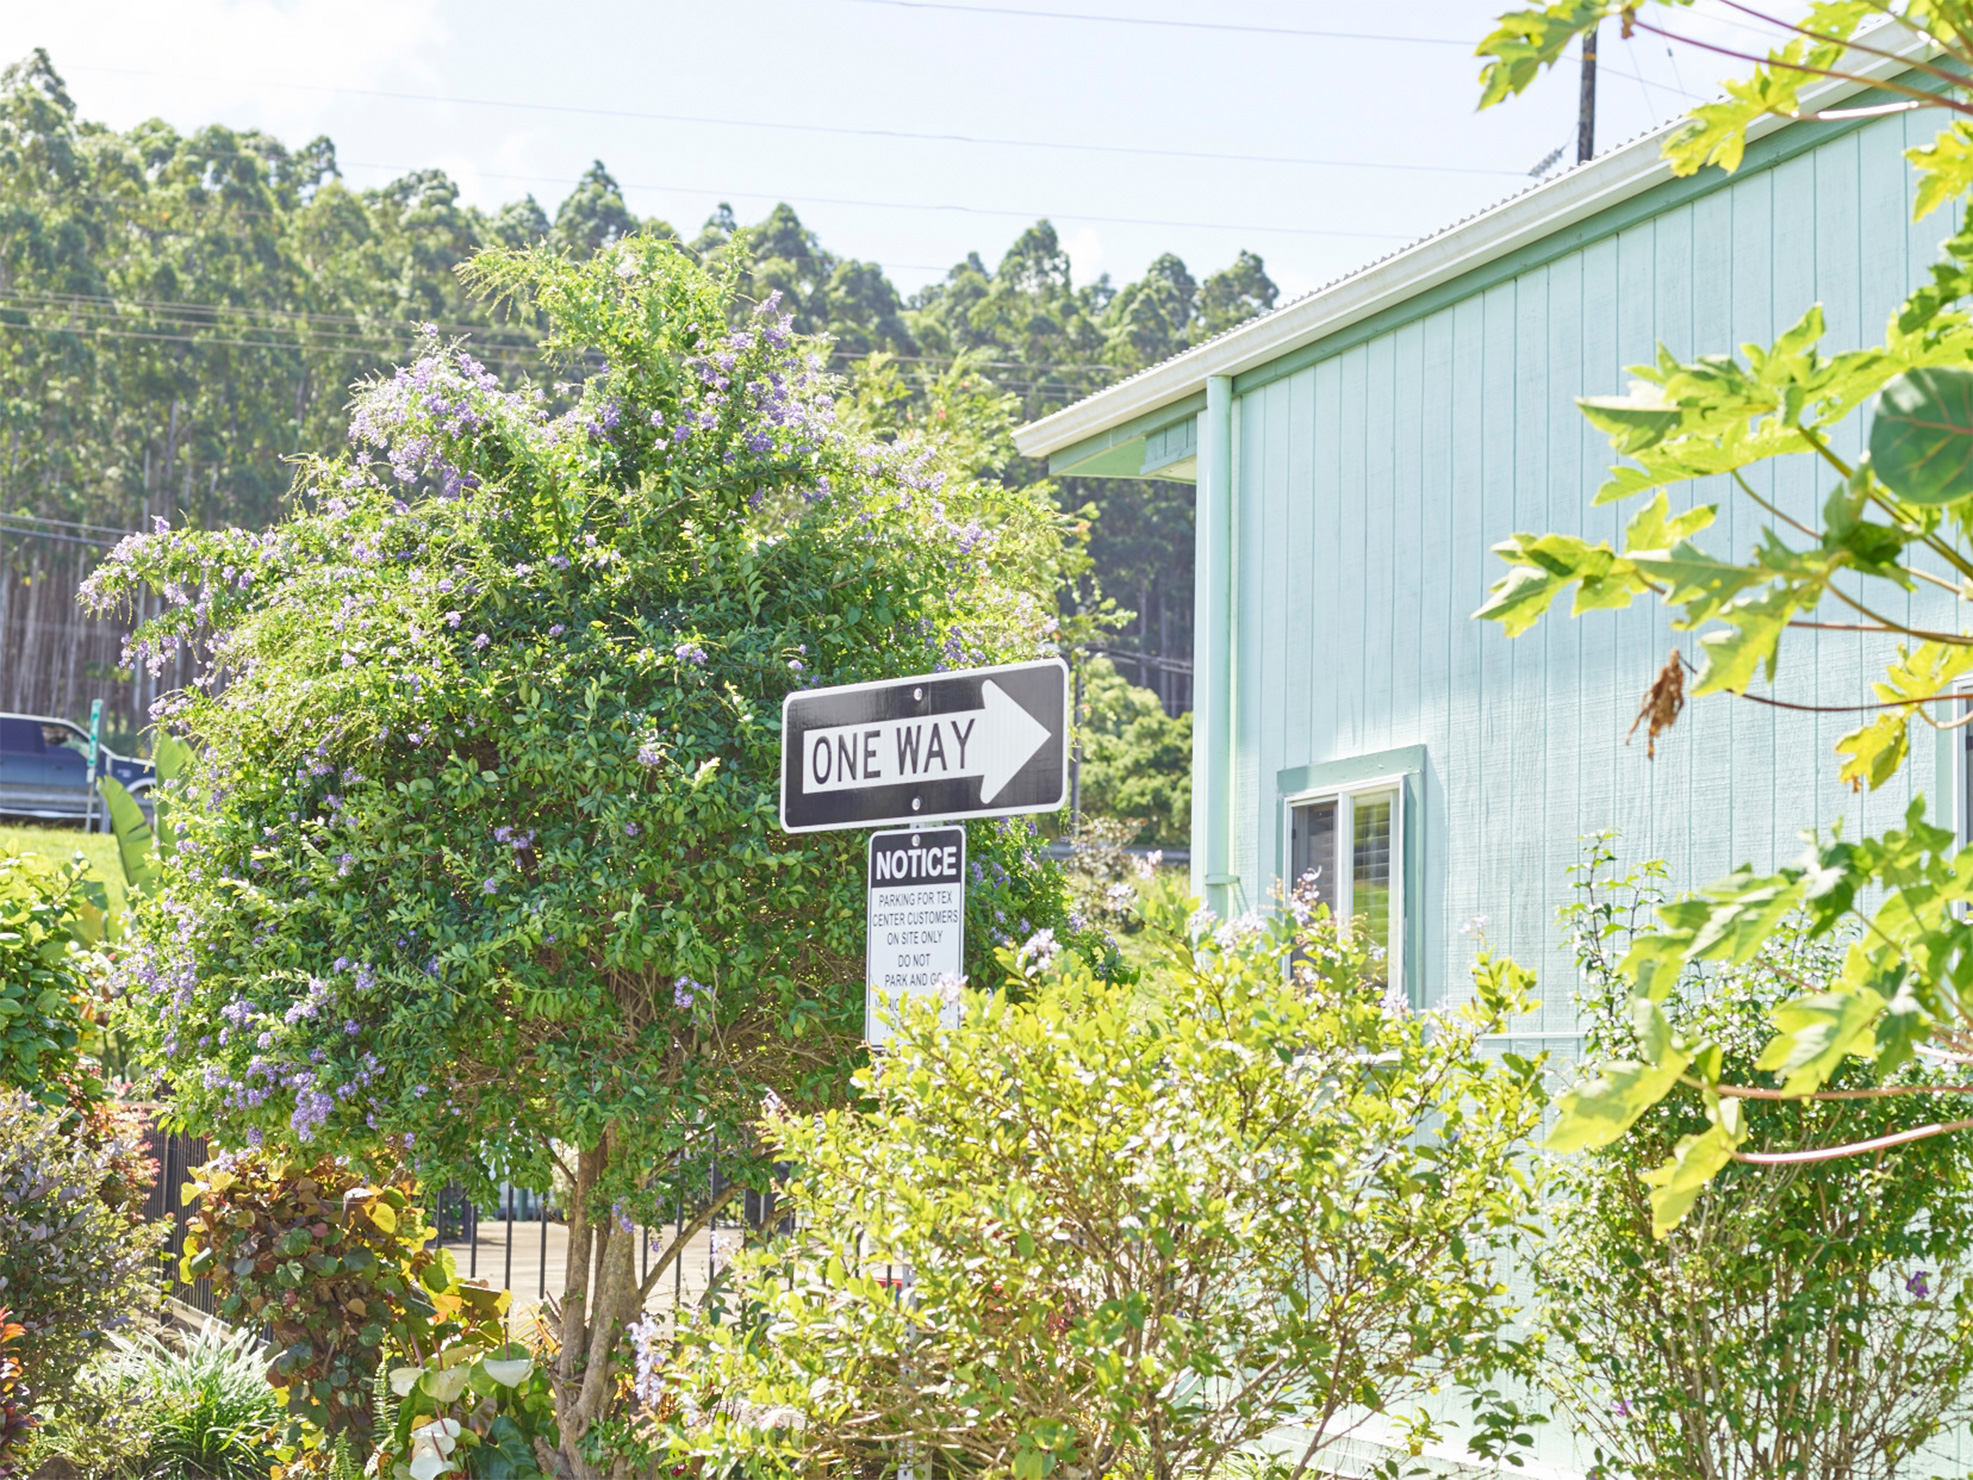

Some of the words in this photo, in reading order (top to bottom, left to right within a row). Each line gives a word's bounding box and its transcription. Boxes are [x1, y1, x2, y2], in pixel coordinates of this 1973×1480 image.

[812, 729, 882, 785] ONE
[896, 718, 976, 776] WAY
[876, 846, 957, 880] NOTICE
[879, 893, 915, 907] PARKING
[917, 892, 934, 905] FOR
[936, 891, 953, 904] TEX
[872, 912, 905, 927] CENTER
[907, 909, 958, 925] CUSTOMERS
[887, 932, 899, 945] ON
[901, 931, 919, 945] SITE
[921, 930, 943, 944] ONLY
[898, 954, 911, 967] DO
[913, 953, 931, 967] NOT
[884, 974, 908, 987] PARK
[910, 973, 928, 986] AND
